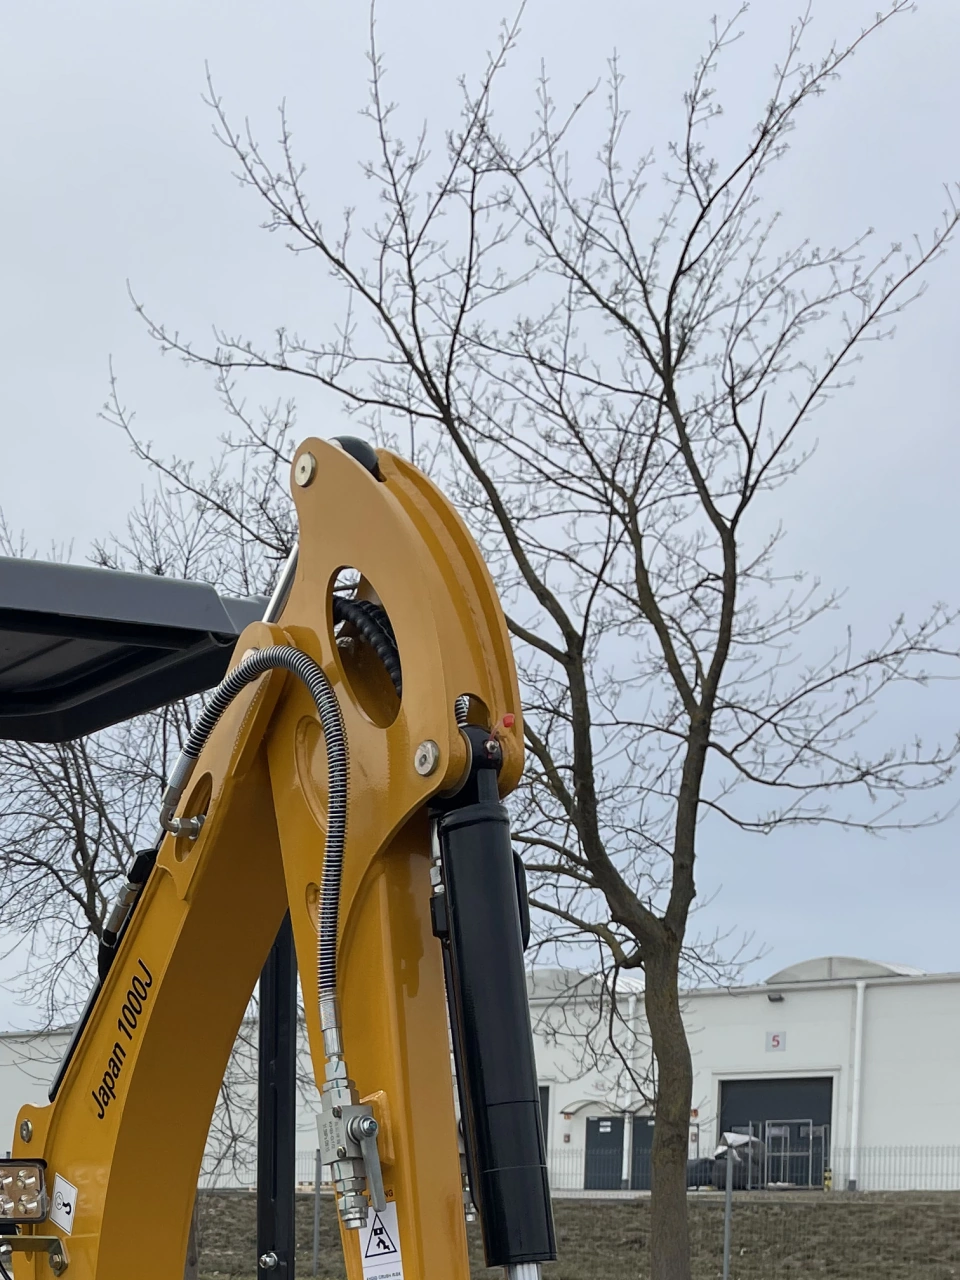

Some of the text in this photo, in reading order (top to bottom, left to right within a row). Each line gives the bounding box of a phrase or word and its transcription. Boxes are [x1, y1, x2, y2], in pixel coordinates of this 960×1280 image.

[92, 958, 153, 1119] Japan 1000J
[772, 1034, 780, 1048] 5
